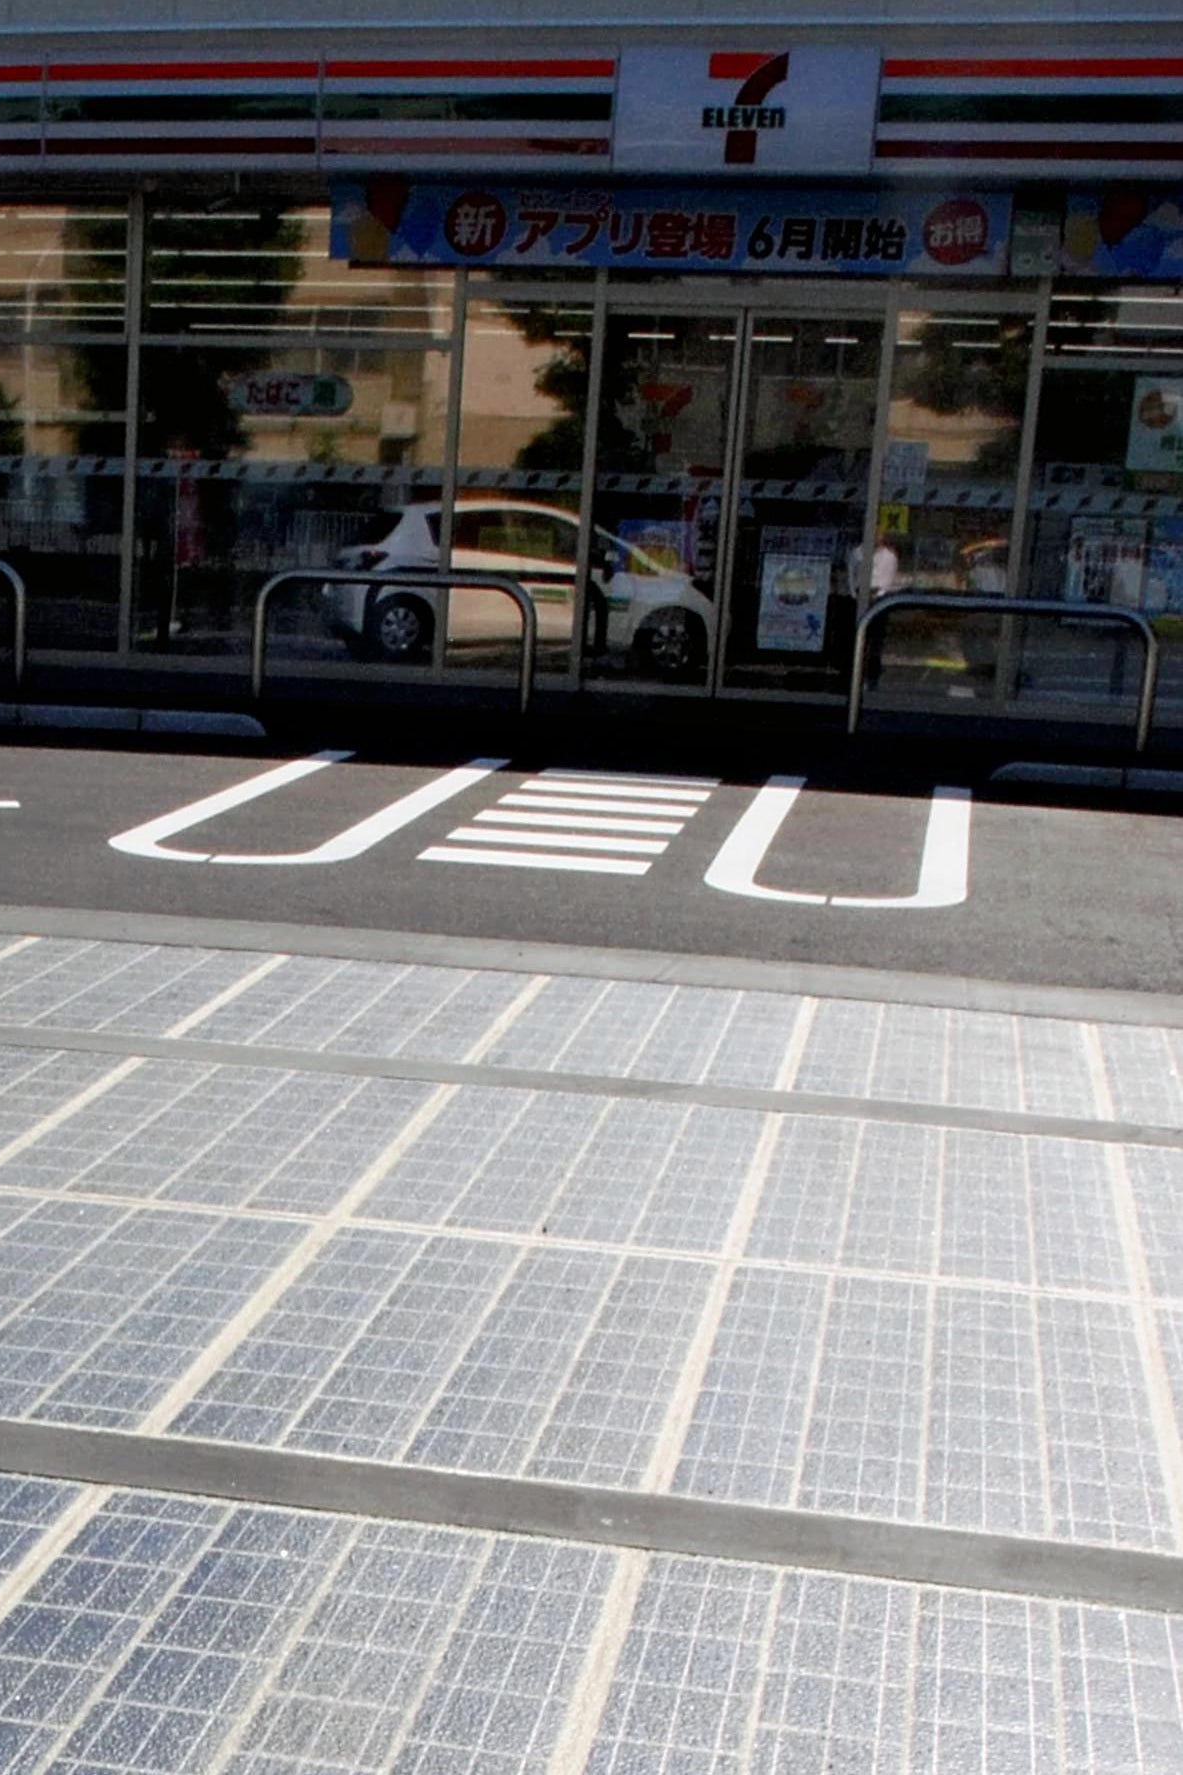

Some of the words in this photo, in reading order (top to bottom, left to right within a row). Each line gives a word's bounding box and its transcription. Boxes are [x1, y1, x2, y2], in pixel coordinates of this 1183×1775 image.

[709, 52, 789, 163] 7
[453, 202, 497, 248] 新
[516, 209, 736, 260] アプリ登場
[747, 215, 907, 261] 6月開始
